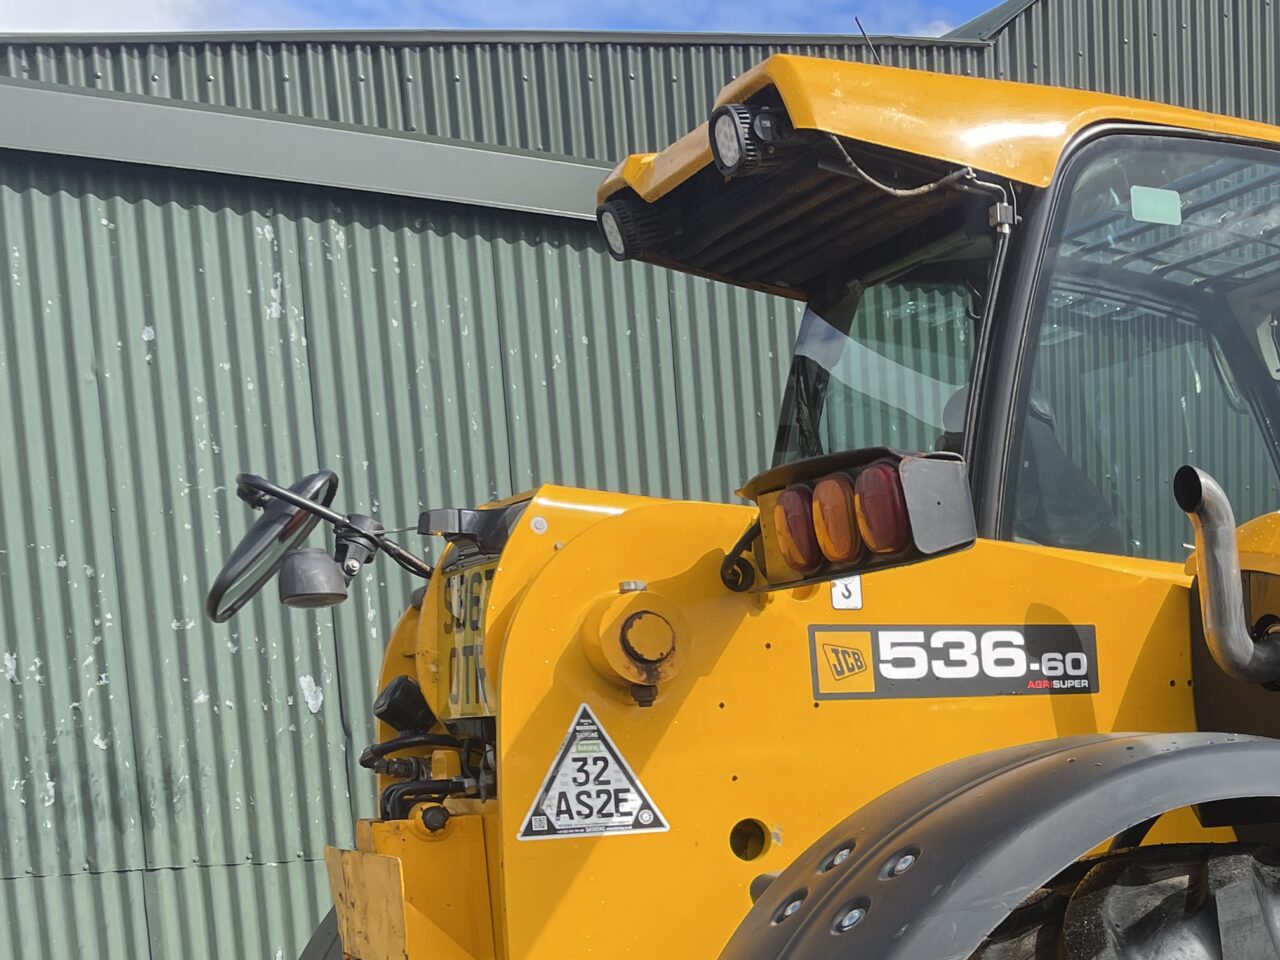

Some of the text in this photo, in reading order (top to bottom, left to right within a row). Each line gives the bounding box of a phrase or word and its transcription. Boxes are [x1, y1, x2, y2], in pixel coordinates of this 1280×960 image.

[831, 630, 1088, 679] JCB 536-60
[571, 756, 611, 786] 32
[556, 788, 633, 821] AS2E
